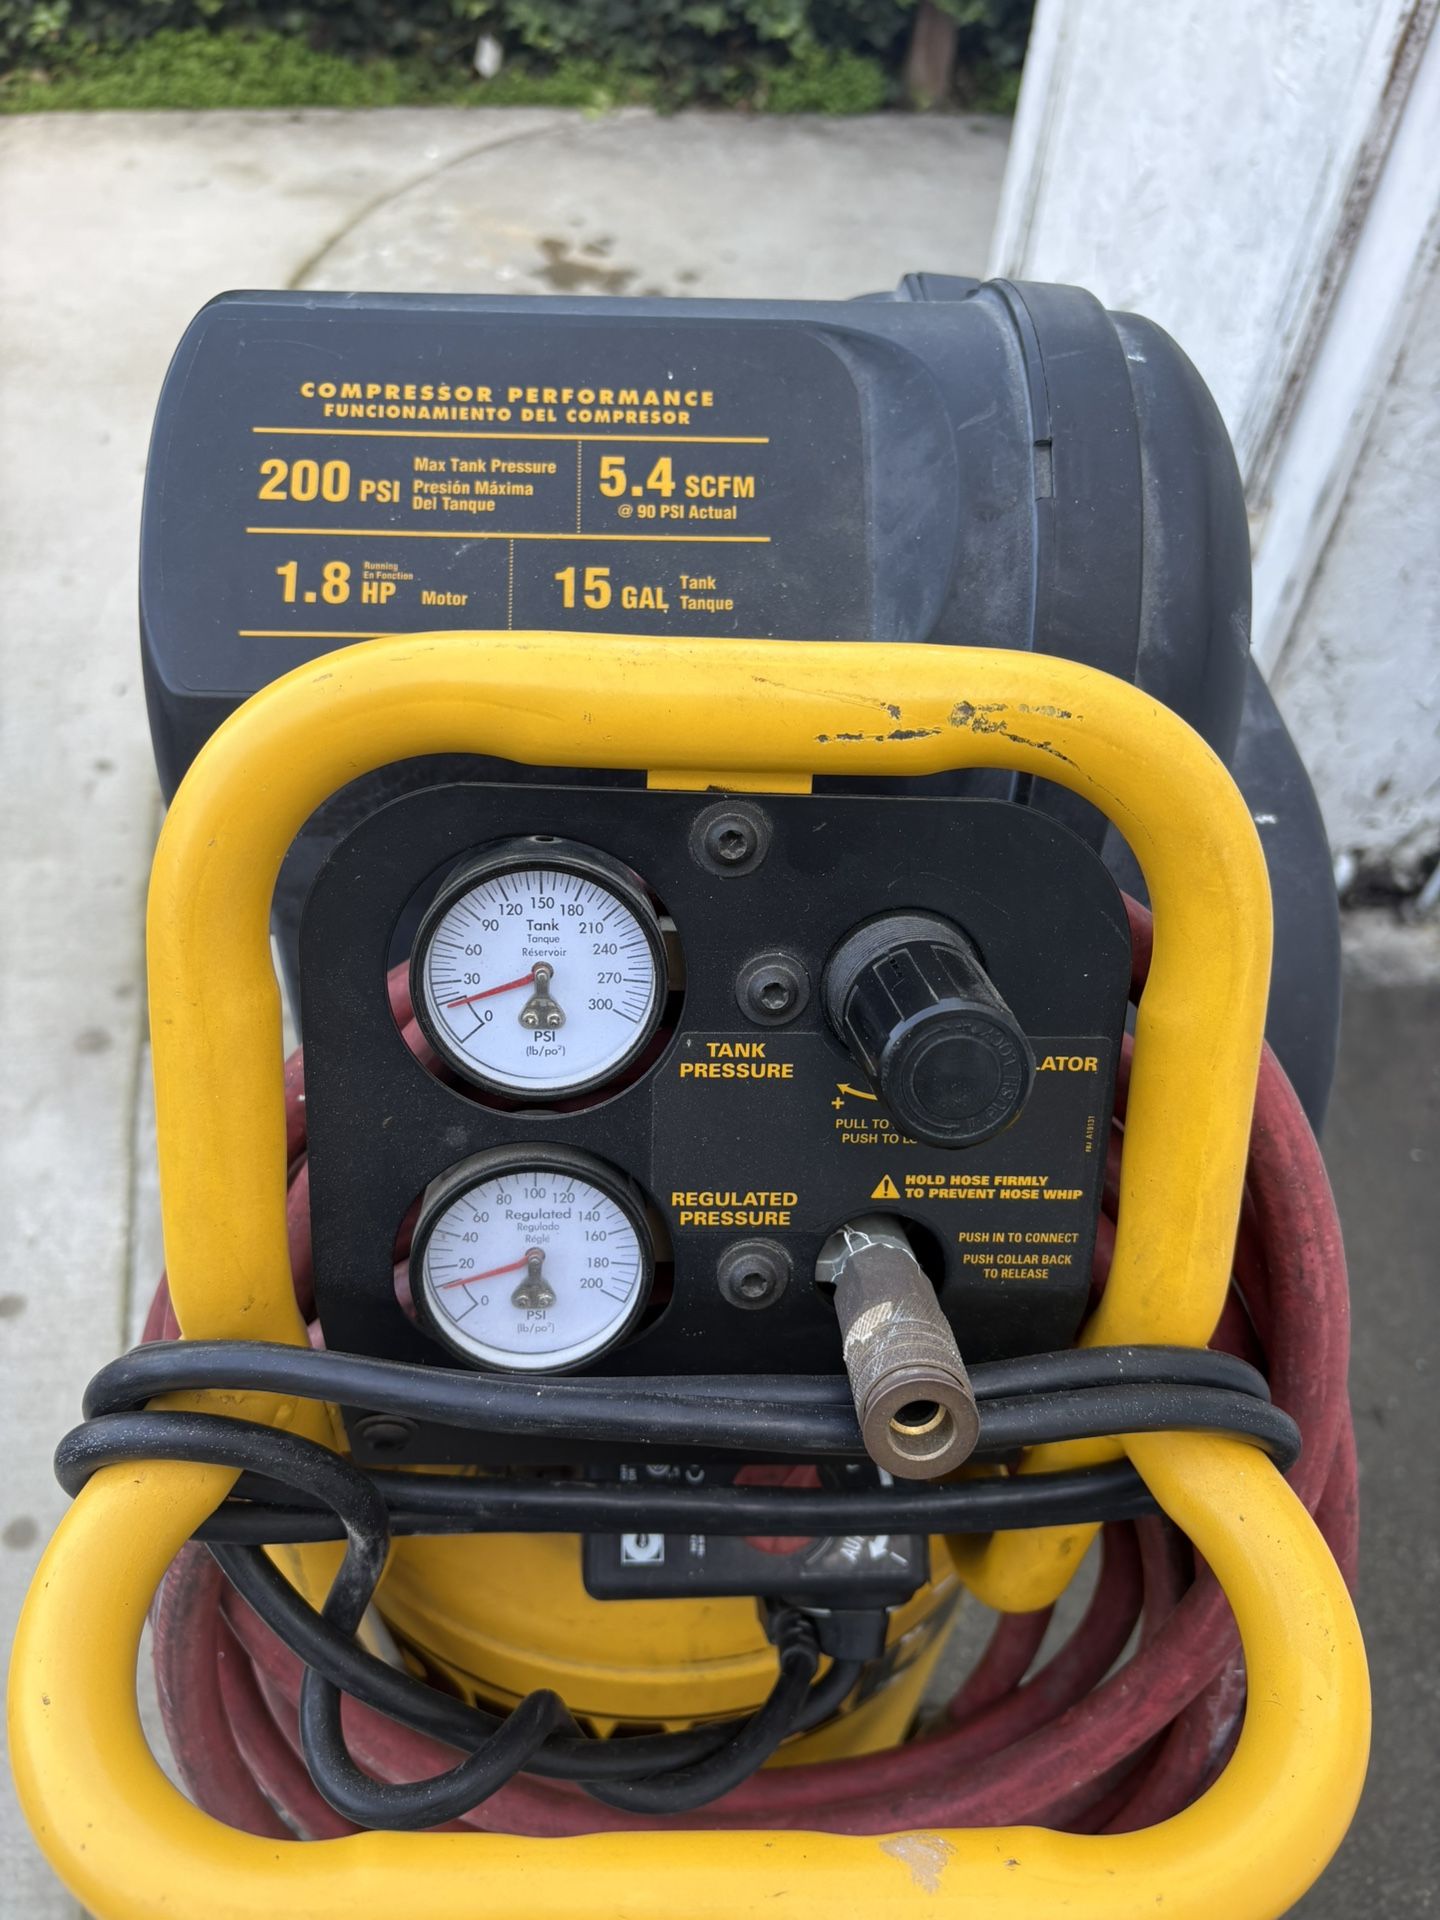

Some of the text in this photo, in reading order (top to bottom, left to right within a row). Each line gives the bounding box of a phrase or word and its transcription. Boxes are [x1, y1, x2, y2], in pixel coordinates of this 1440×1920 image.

[301, 382, 715, 407] COMPRESSOR PERFORMANCE
[323, 403, 691, 425] FUNCIONAMIENTO DEL COMPRESOR
[413, 457, 557, 474] Max Tank Pressure
[257, 459, 401, 503] 200 PSI
[599, 456, 756, 499] 5.4 SCFM
[413, 479, 534, 496] Presión Máxima
[412, 496, 496, 514] Del Tanque
[617, 504, 738, 520] @ 90 PSI Actual
[364, 561, 399, 571] Running
[363, 571, 414, 580] En Fonction
[275, 560, 397, 605] 1.8 HP
[679, 574, 717, 590] Tank
[554, 566, 669, 611] 15 GAL
[421, 590, 469, 606] Motor
[679, 595, 734, 612] Tanque
[531, 897, 555, 909] 150
[499, 904, 523, 916] 120
[560, 904, 584, 917] 180
[482, 919, 499, 932] 90
[526, 918, 559, 931] Tank
[579, 922, 604, 935] 210
[527, 934, 560, 944] Tanque
[465, 944, 483, 956] 60
[522, 947, 567, 957] Réservoir
[593, 943, 618, 956] 240
[463, 973, 481, 985] 30
[597, 972, 622, 984] 270
[588, 999, 613, 1010] 300
[484, 1010, 493, 1022] 0
[534, 1031, 556, 1042] PSI
[706, 1042, 766, 1058] TANK
[1035, 1056, 1098, 1072] ATOR
[679, 1062, 794, 1079] PRESSURE
[835, 1119, 869, 1129] PULL
[872, 1119, 890, 1129] TO
[842, 1133, 878, 1143] PUSH
[882, 1134, 899, 1144] TO
[905, 1174, 1048, 1187] HOLD HOSE FIRMLY
[496, 1194, 512, 1205] 80
[524, 1188, 546, 1199] 100
[553, 1193, 575, 1203] 120
[671, 1191, 798, 1207] REGULATED
[905, 1188, 1084, 1200] TO PREVENT HOSE WHIP
[473, 1212, 489, 1223] 60
[505, 1208, 572, 1221] Regulated
[579, 1210, 601, 1221] 140
[679, 1211, 791, 1226] PRESSURE
[517, 1223, 560, 1232] Regulado
[462, 1232, 478, 1242] 40
[585, 1231, 607, 1241] 160
[959, 1232, 1079, 1243] PUSH IN TO CONNECT
[459, 1258, 475, 1269] 20
[587, 1257, 609, 1268] 180
[963, 1254, 1072, 1264] PUSH COLLAR BACK
[984, 1268, 1049, 1278] TO RELEASE
[580, 1278, 603, 1289] 200
[481, 1296, 489, 1305] 0
[526, 1311, 546, 1320] PSI
